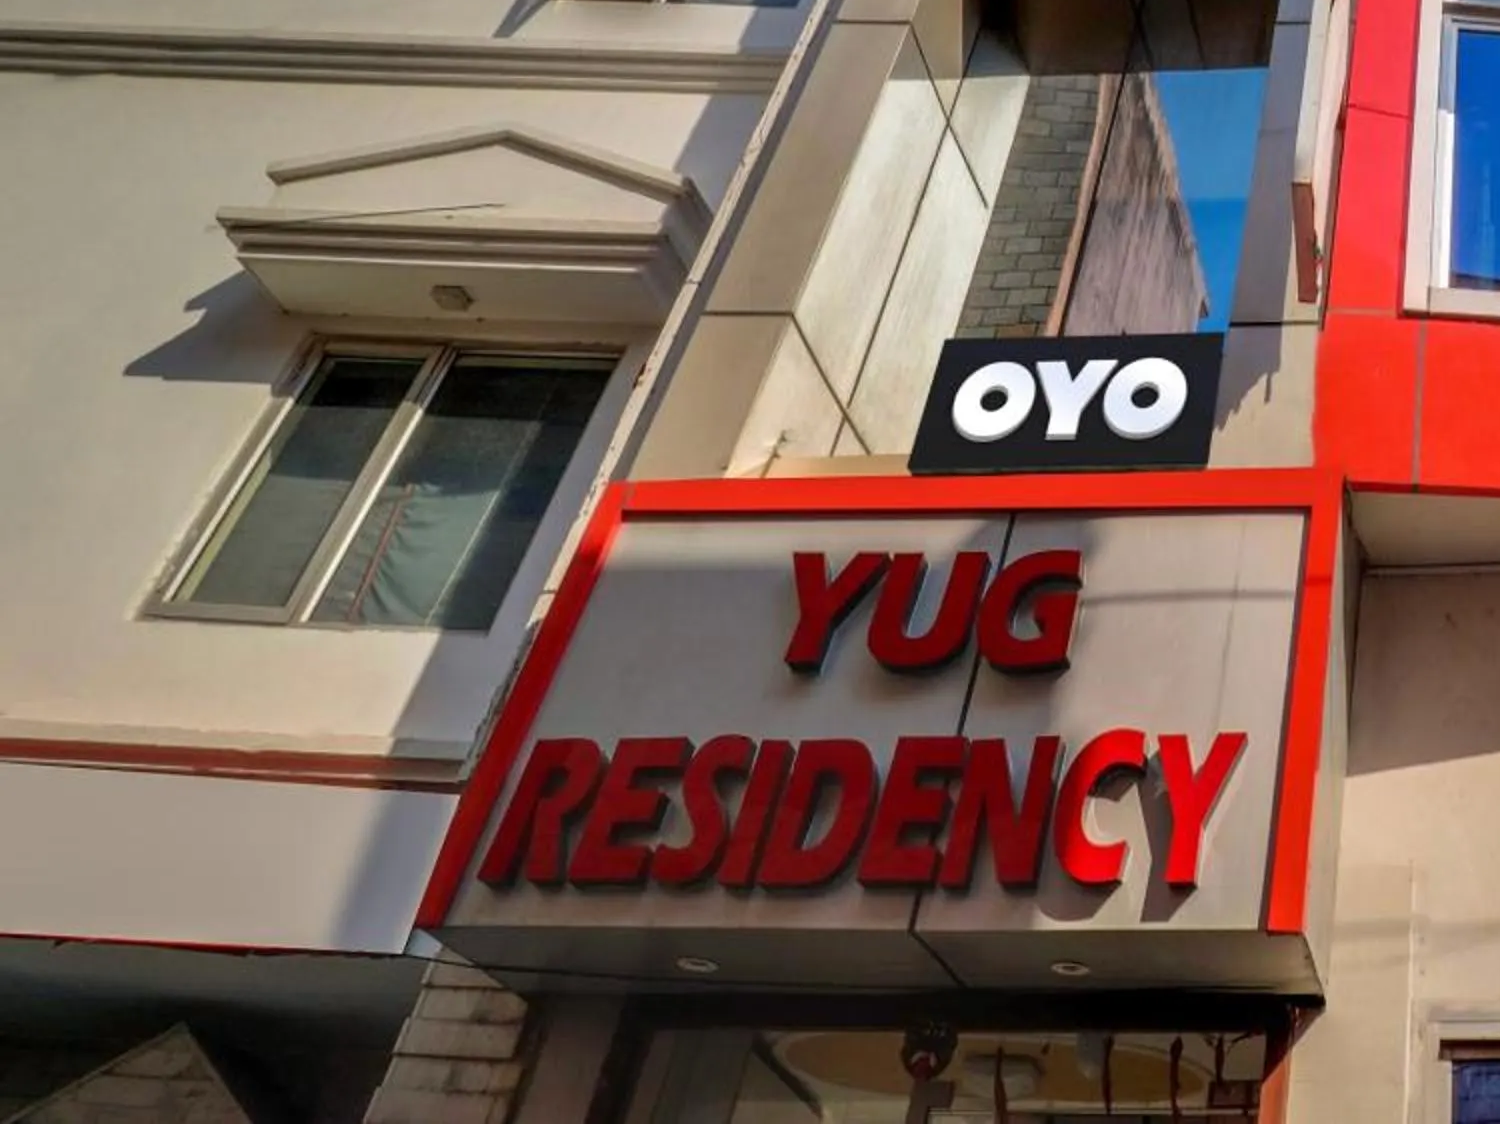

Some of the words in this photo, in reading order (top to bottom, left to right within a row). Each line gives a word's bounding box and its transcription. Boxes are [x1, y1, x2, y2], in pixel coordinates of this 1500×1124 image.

[951, 356, 1188, 443] OYO
[783, 549, 1084, 674] YUG
[477, 727, 1249, 892] RESIDENCY
